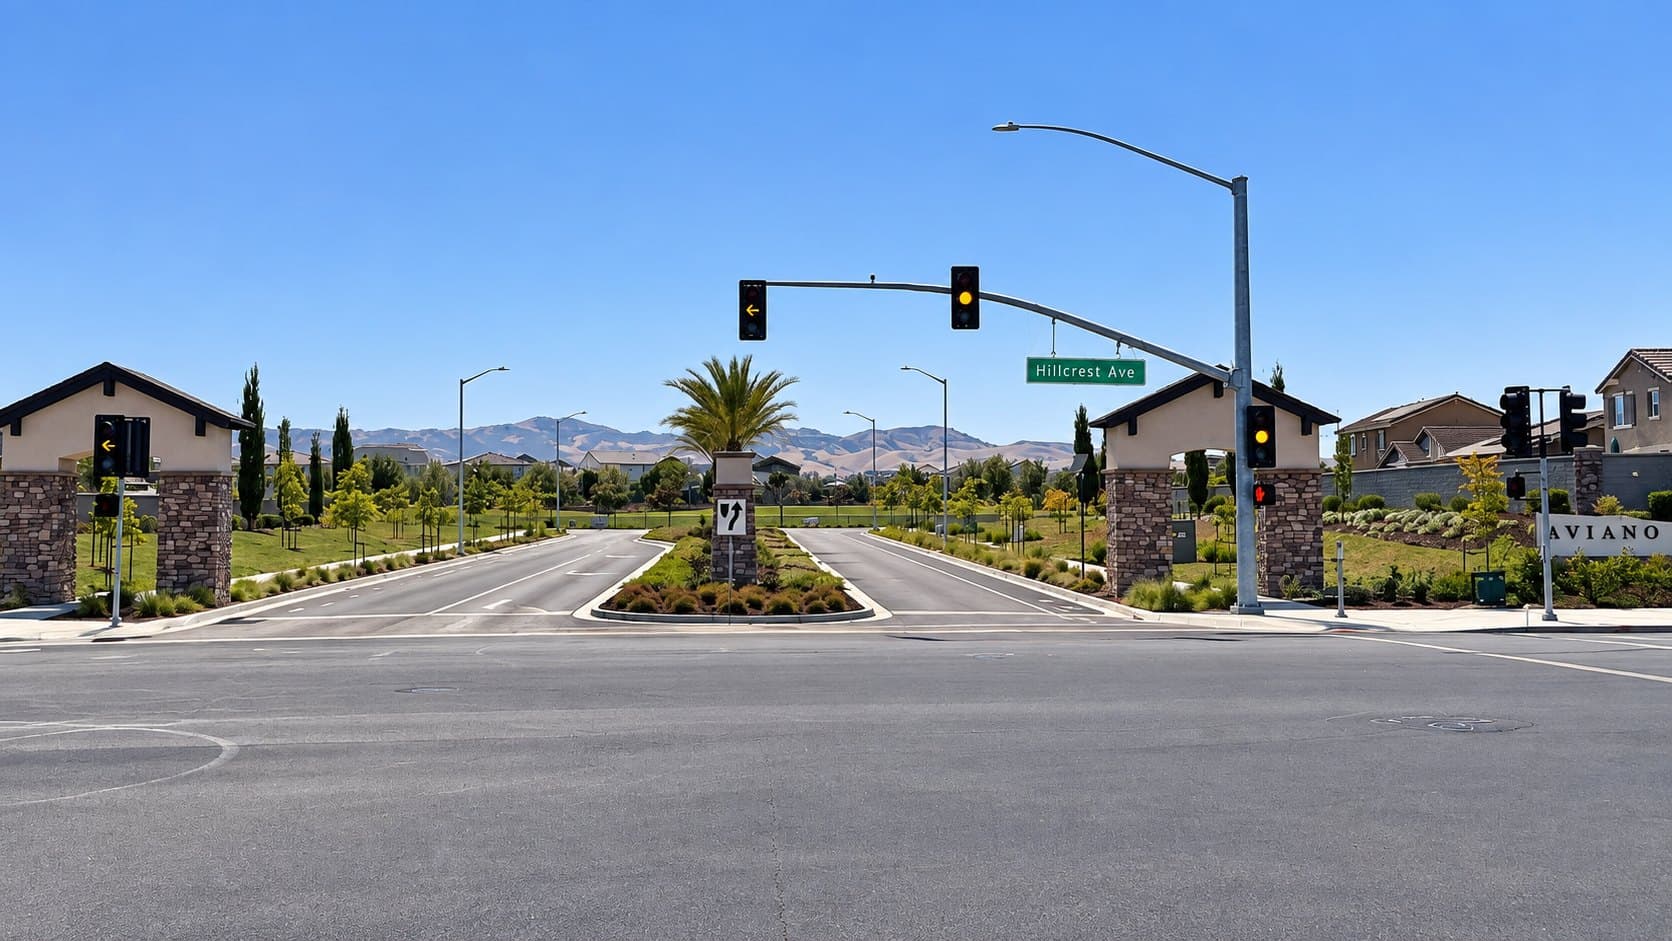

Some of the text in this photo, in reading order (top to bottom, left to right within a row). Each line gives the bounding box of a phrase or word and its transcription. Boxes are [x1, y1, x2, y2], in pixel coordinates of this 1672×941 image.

[1036, 364, 1135, 378] Hillcrest Ave
[1549, 525, 1659, 539] AVIANO
